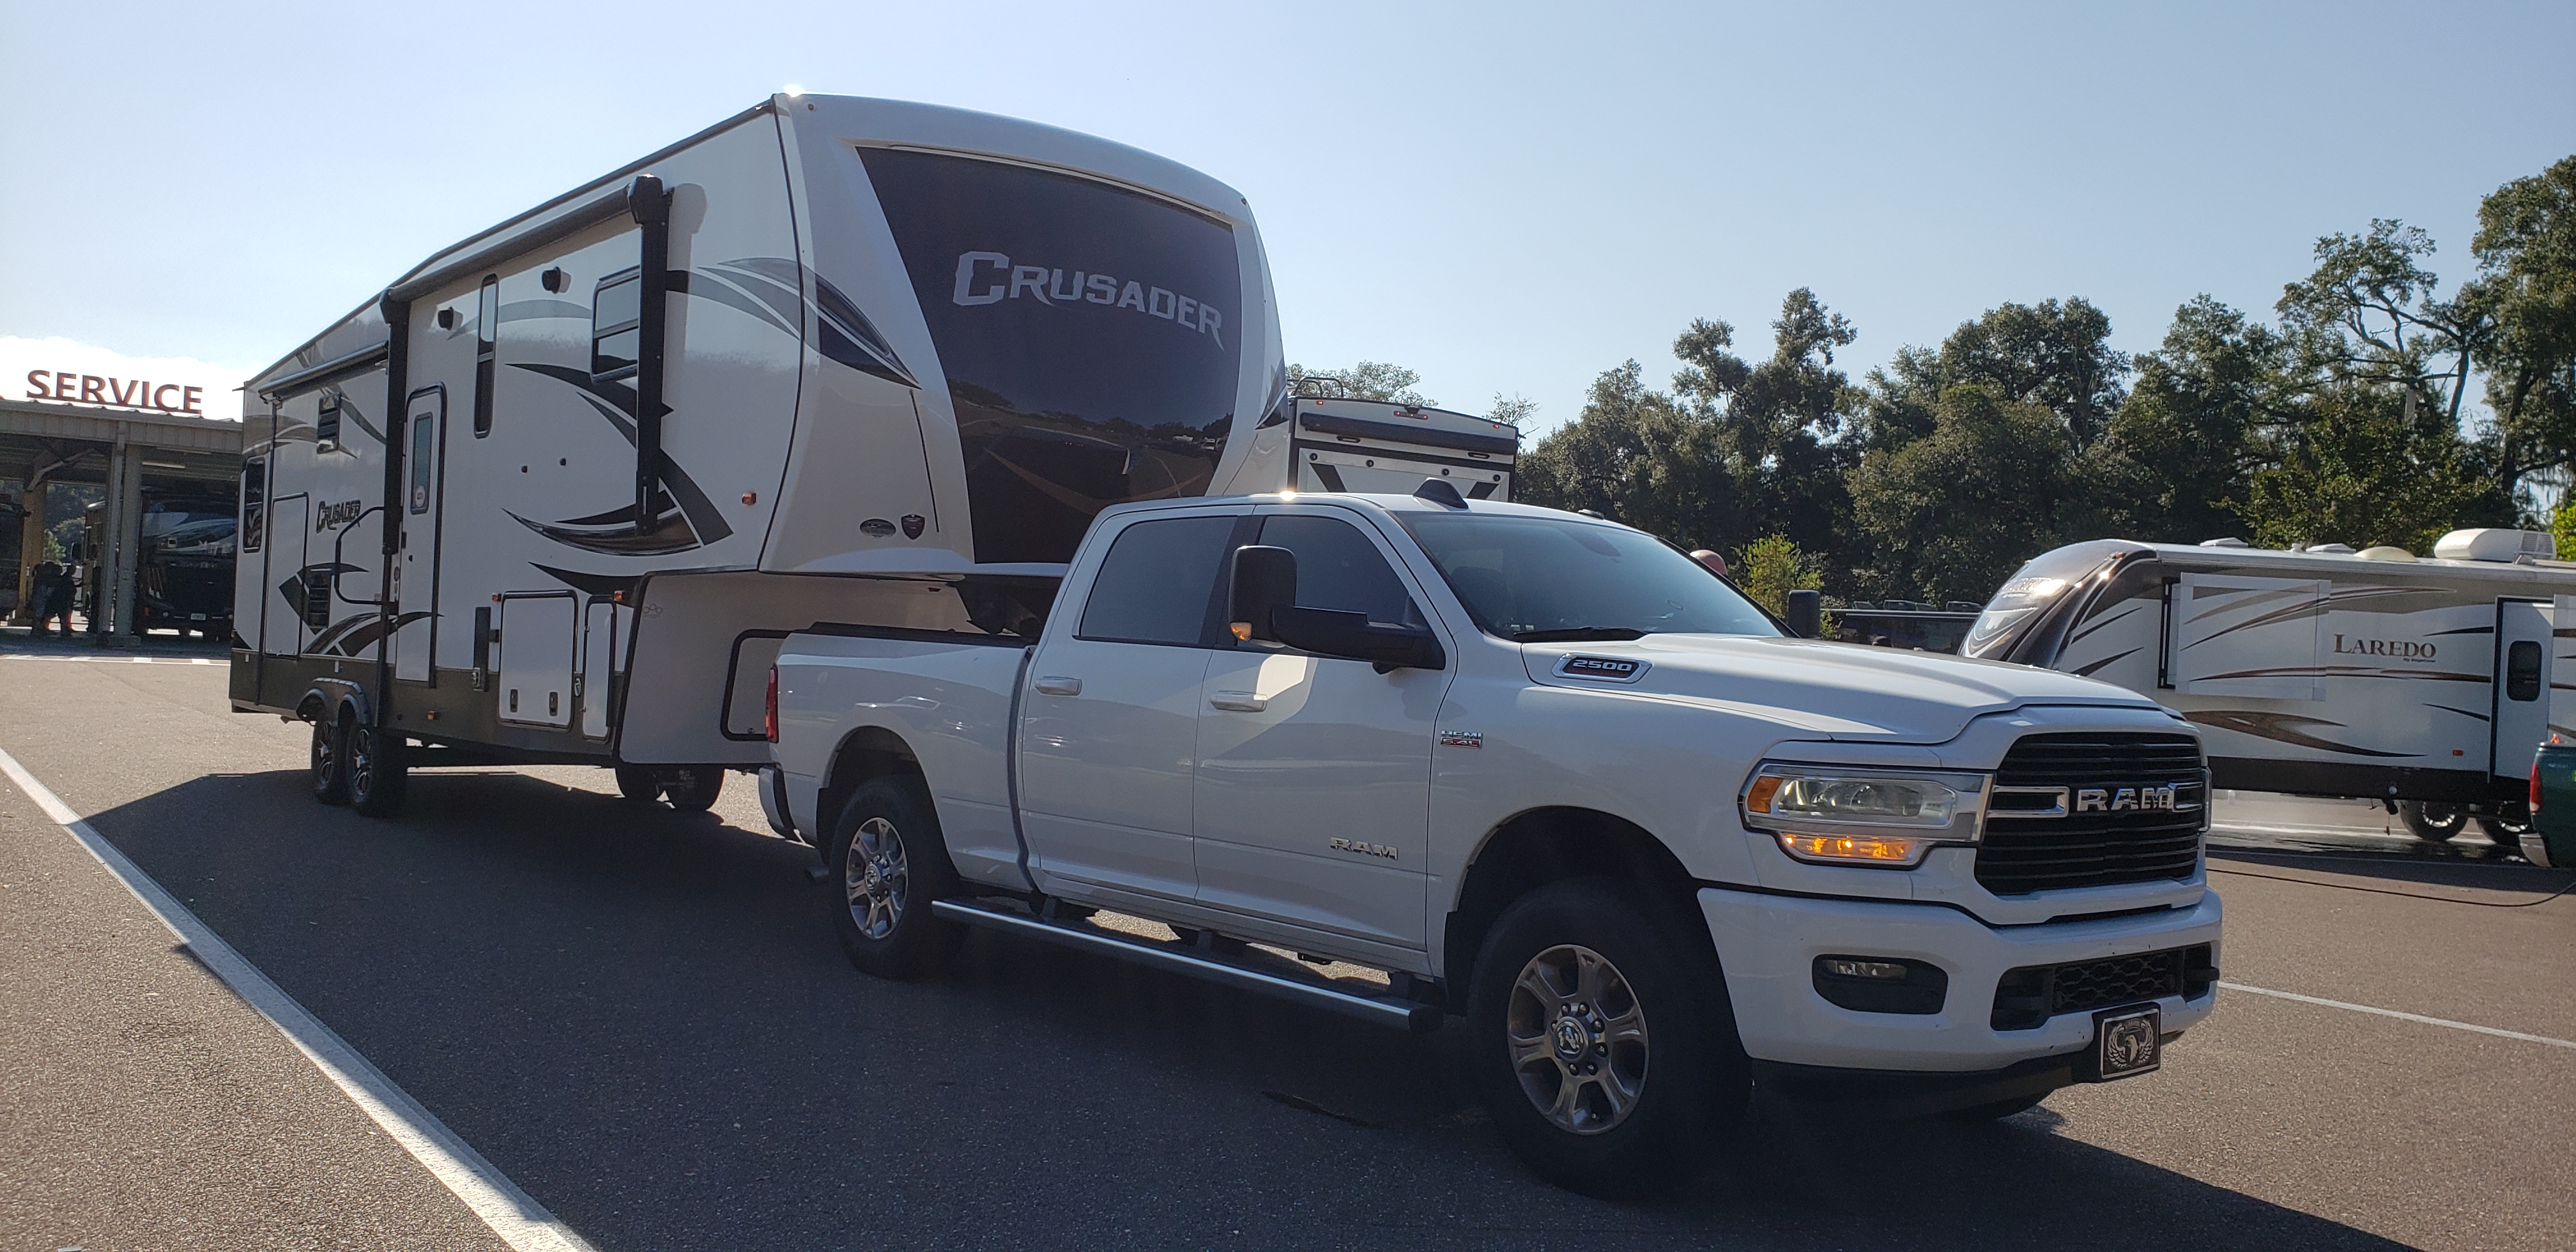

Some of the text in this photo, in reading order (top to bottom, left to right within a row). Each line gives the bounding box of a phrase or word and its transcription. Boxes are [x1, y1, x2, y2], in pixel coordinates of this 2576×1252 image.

[953, 251, 1225, 351] CRUSADER
[26, 369, 203, 416] SERVICE
[2333, 634, 2436, 658] LAREDO
[1572, 659, 1632, 671] 2500
[1441, 729, 1483, 739] HEMI
[2076, 787, 2173, 812] RAM
[1330, 837, 1398, 860] RAM
